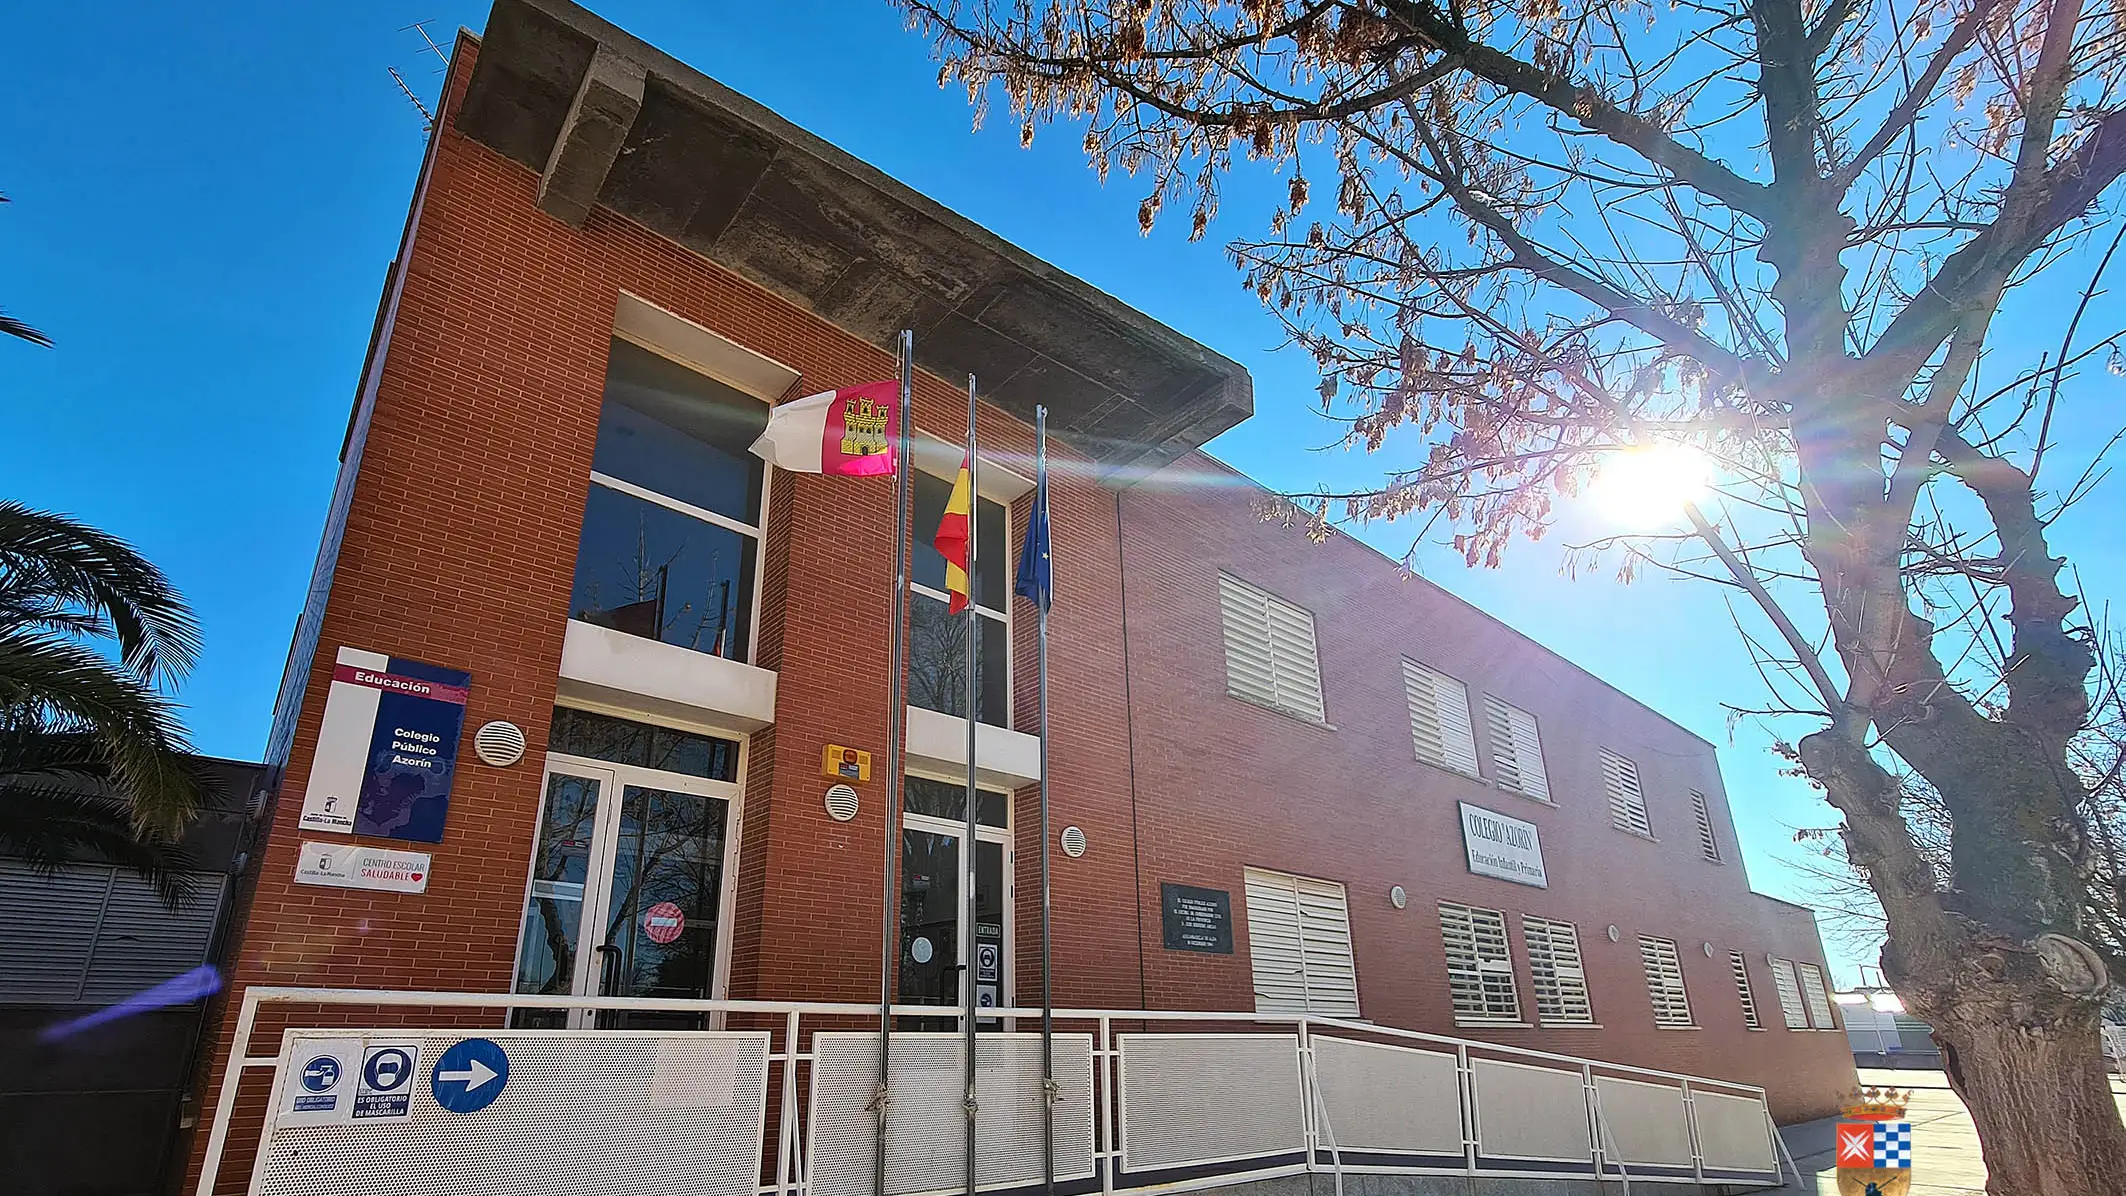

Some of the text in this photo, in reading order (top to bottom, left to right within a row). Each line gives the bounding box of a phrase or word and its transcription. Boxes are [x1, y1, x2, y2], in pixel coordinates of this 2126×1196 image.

[354, 671, 430, 694] Educación
[394, 728, 440, 743] Colegio
[391, 740, 437, 756] Público
[392, 754, 432, 768] Azorín
[331, 818, 352, 826] Mancha
[1469, 813, 1503, 843] COLEGIO
[362, 857, 426, 872] CENTRO ESCOLAR
[1471, 849, 1498, 867] Educación
[1520, 862, 1542, 877] Primaria
[360, 868, 409, 881] SALUDABLE
[978, 925, 999, 935] ENTRADA
[365, 1095, 407, 1103] OBLIGATORIO
[364, 1108, 404, 1116] MASCARILLA
